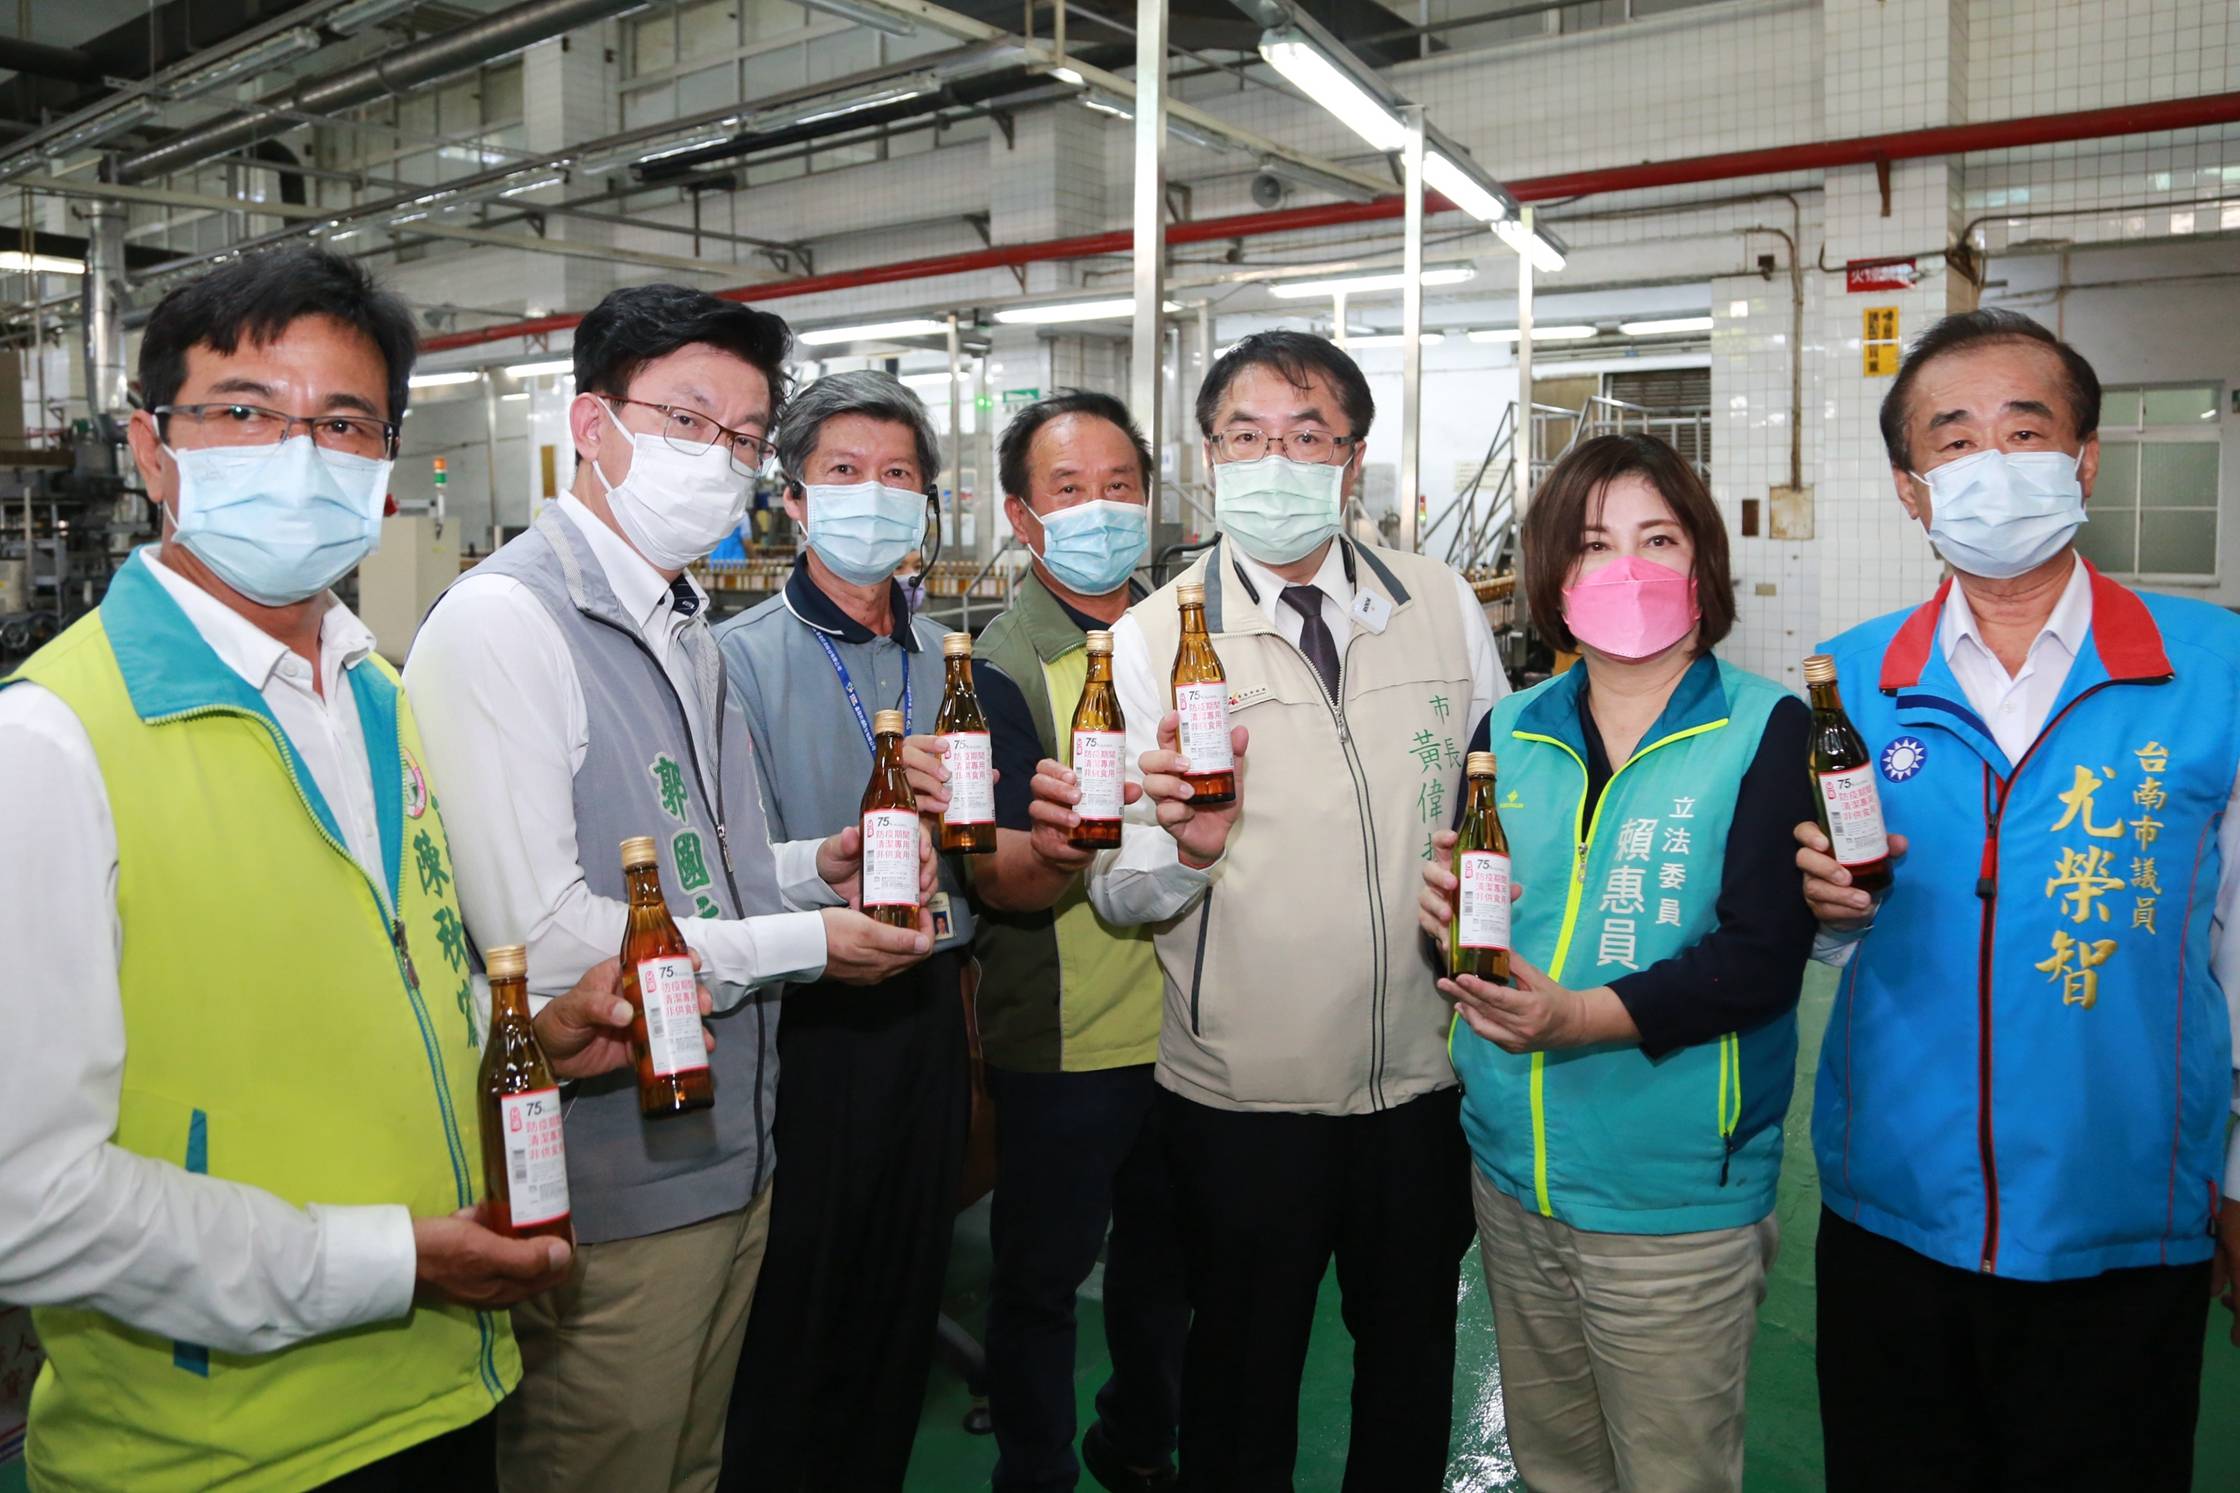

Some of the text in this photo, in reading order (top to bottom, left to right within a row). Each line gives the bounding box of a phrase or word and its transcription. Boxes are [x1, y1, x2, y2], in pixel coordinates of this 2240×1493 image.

[1429, 694, 1463, 769] 市長
[651, 755, 720, 919] 郭國
[1596, 817, 1659, 971] 賴惠員
[1655, 796, 1696, 928] 立法委員
[2034, 764, 2127, 1011] 尤榮智
[2129, 741, 2169, 935] 台南市議員
